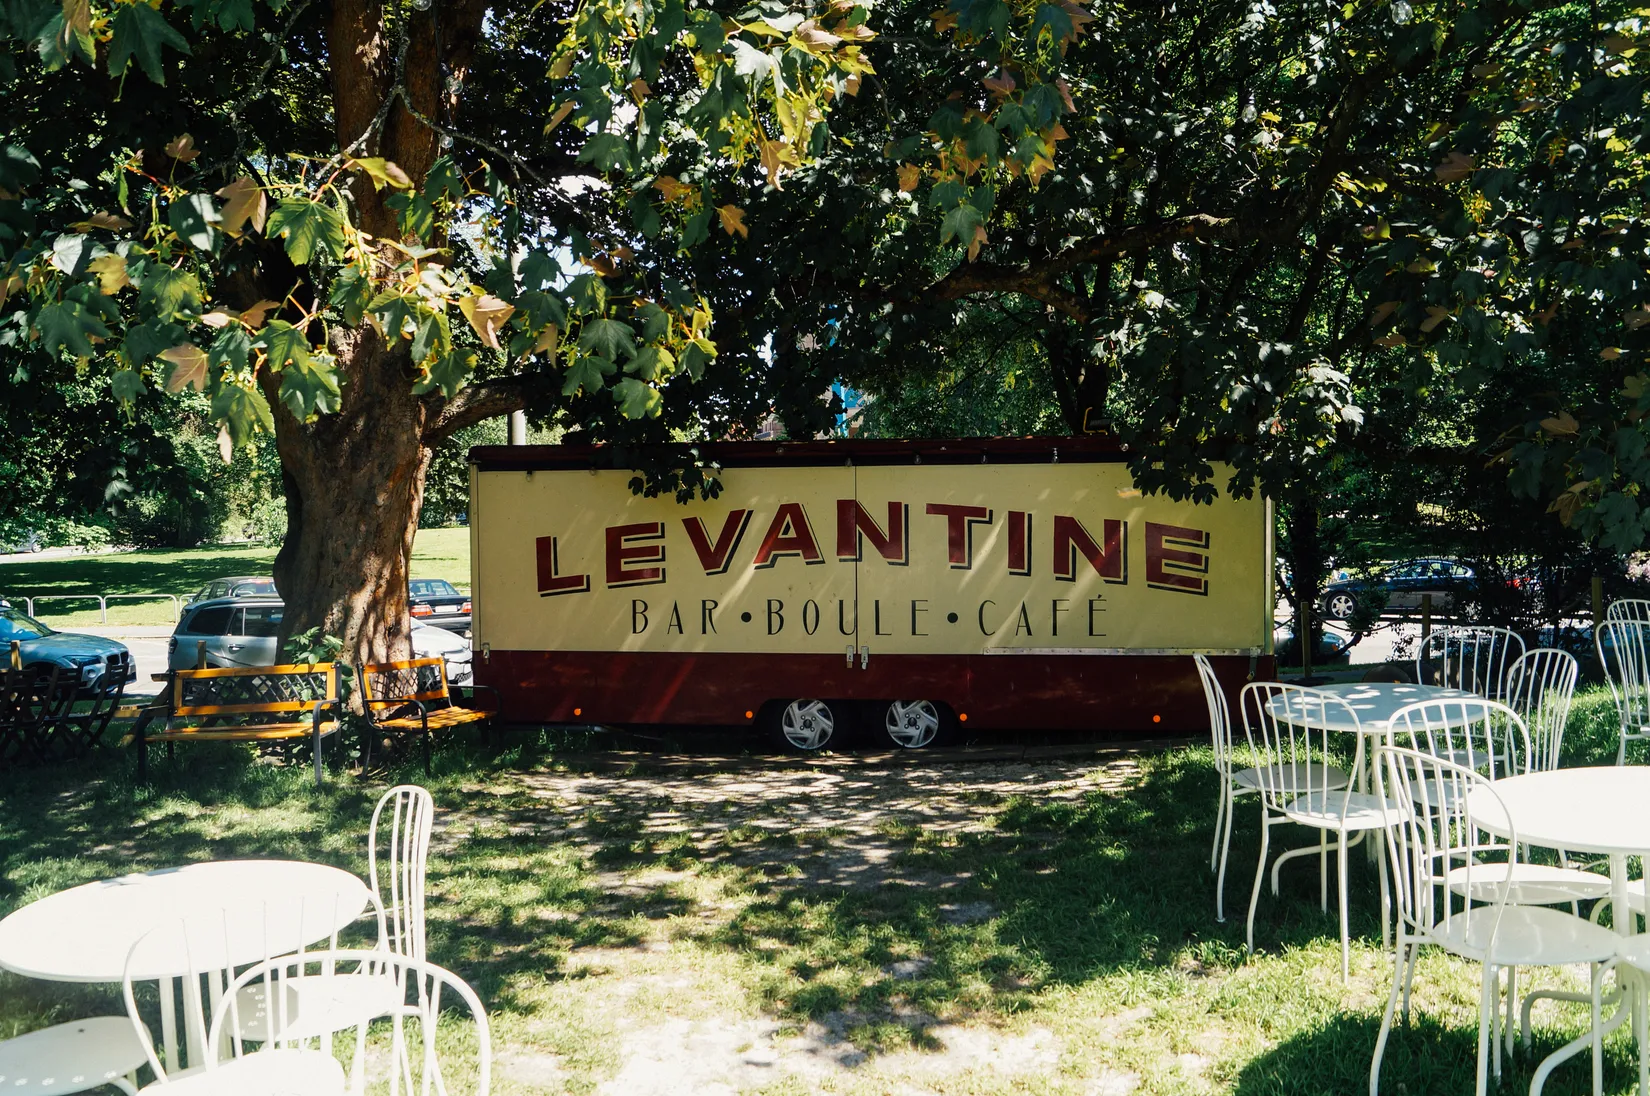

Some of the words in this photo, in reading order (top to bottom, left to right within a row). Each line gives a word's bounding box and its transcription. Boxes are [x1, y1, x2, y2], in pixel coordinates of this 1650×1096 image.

[535, 498, 1210, 598] LEVANTINE
[631, 599, 718, 636] BAR
[766, 599, 930, 637] BOULE
[977, 594, 1108, 637] CAFÉ
